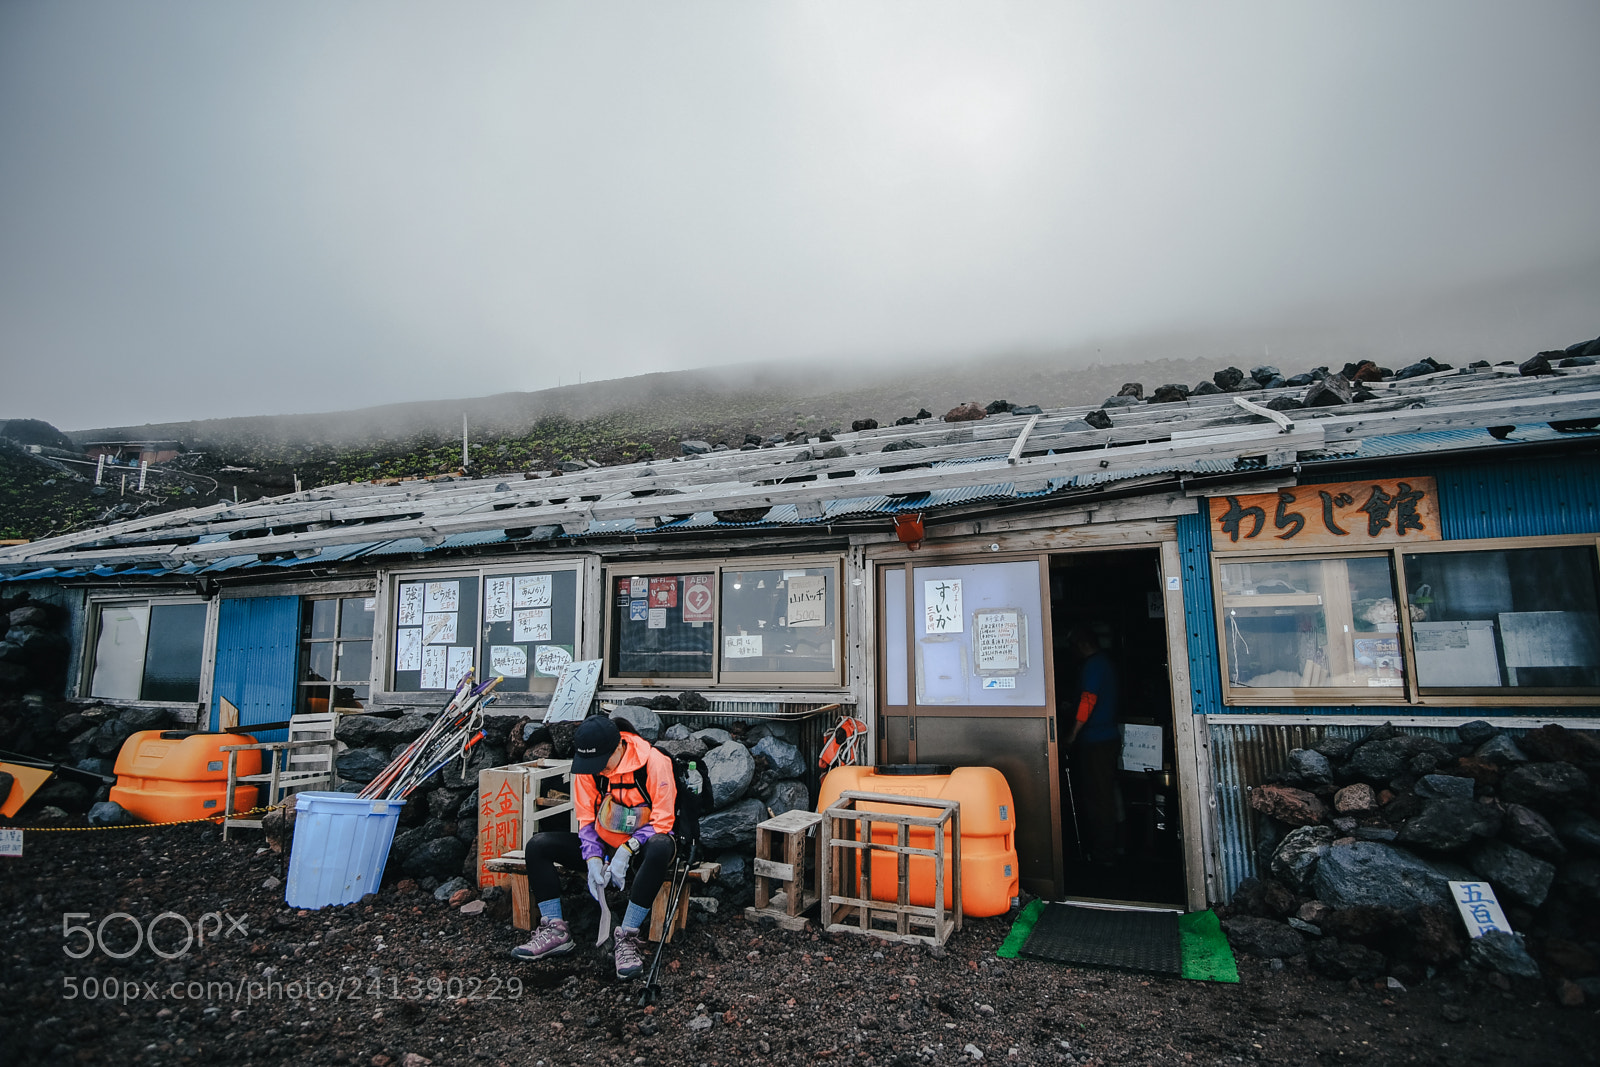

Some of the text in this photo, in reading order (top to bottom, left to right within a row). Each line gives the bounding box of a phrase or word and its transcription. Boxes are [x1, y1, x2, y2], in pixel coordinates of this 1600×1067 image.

[1217, 482, 1425, 542] わらじ館
[689, 576, 707, 584] AED
[935, 582, 951, 629] すいか
[560, 668, 582, 718] ストック
[495, 778, 519, 880] 金剛
